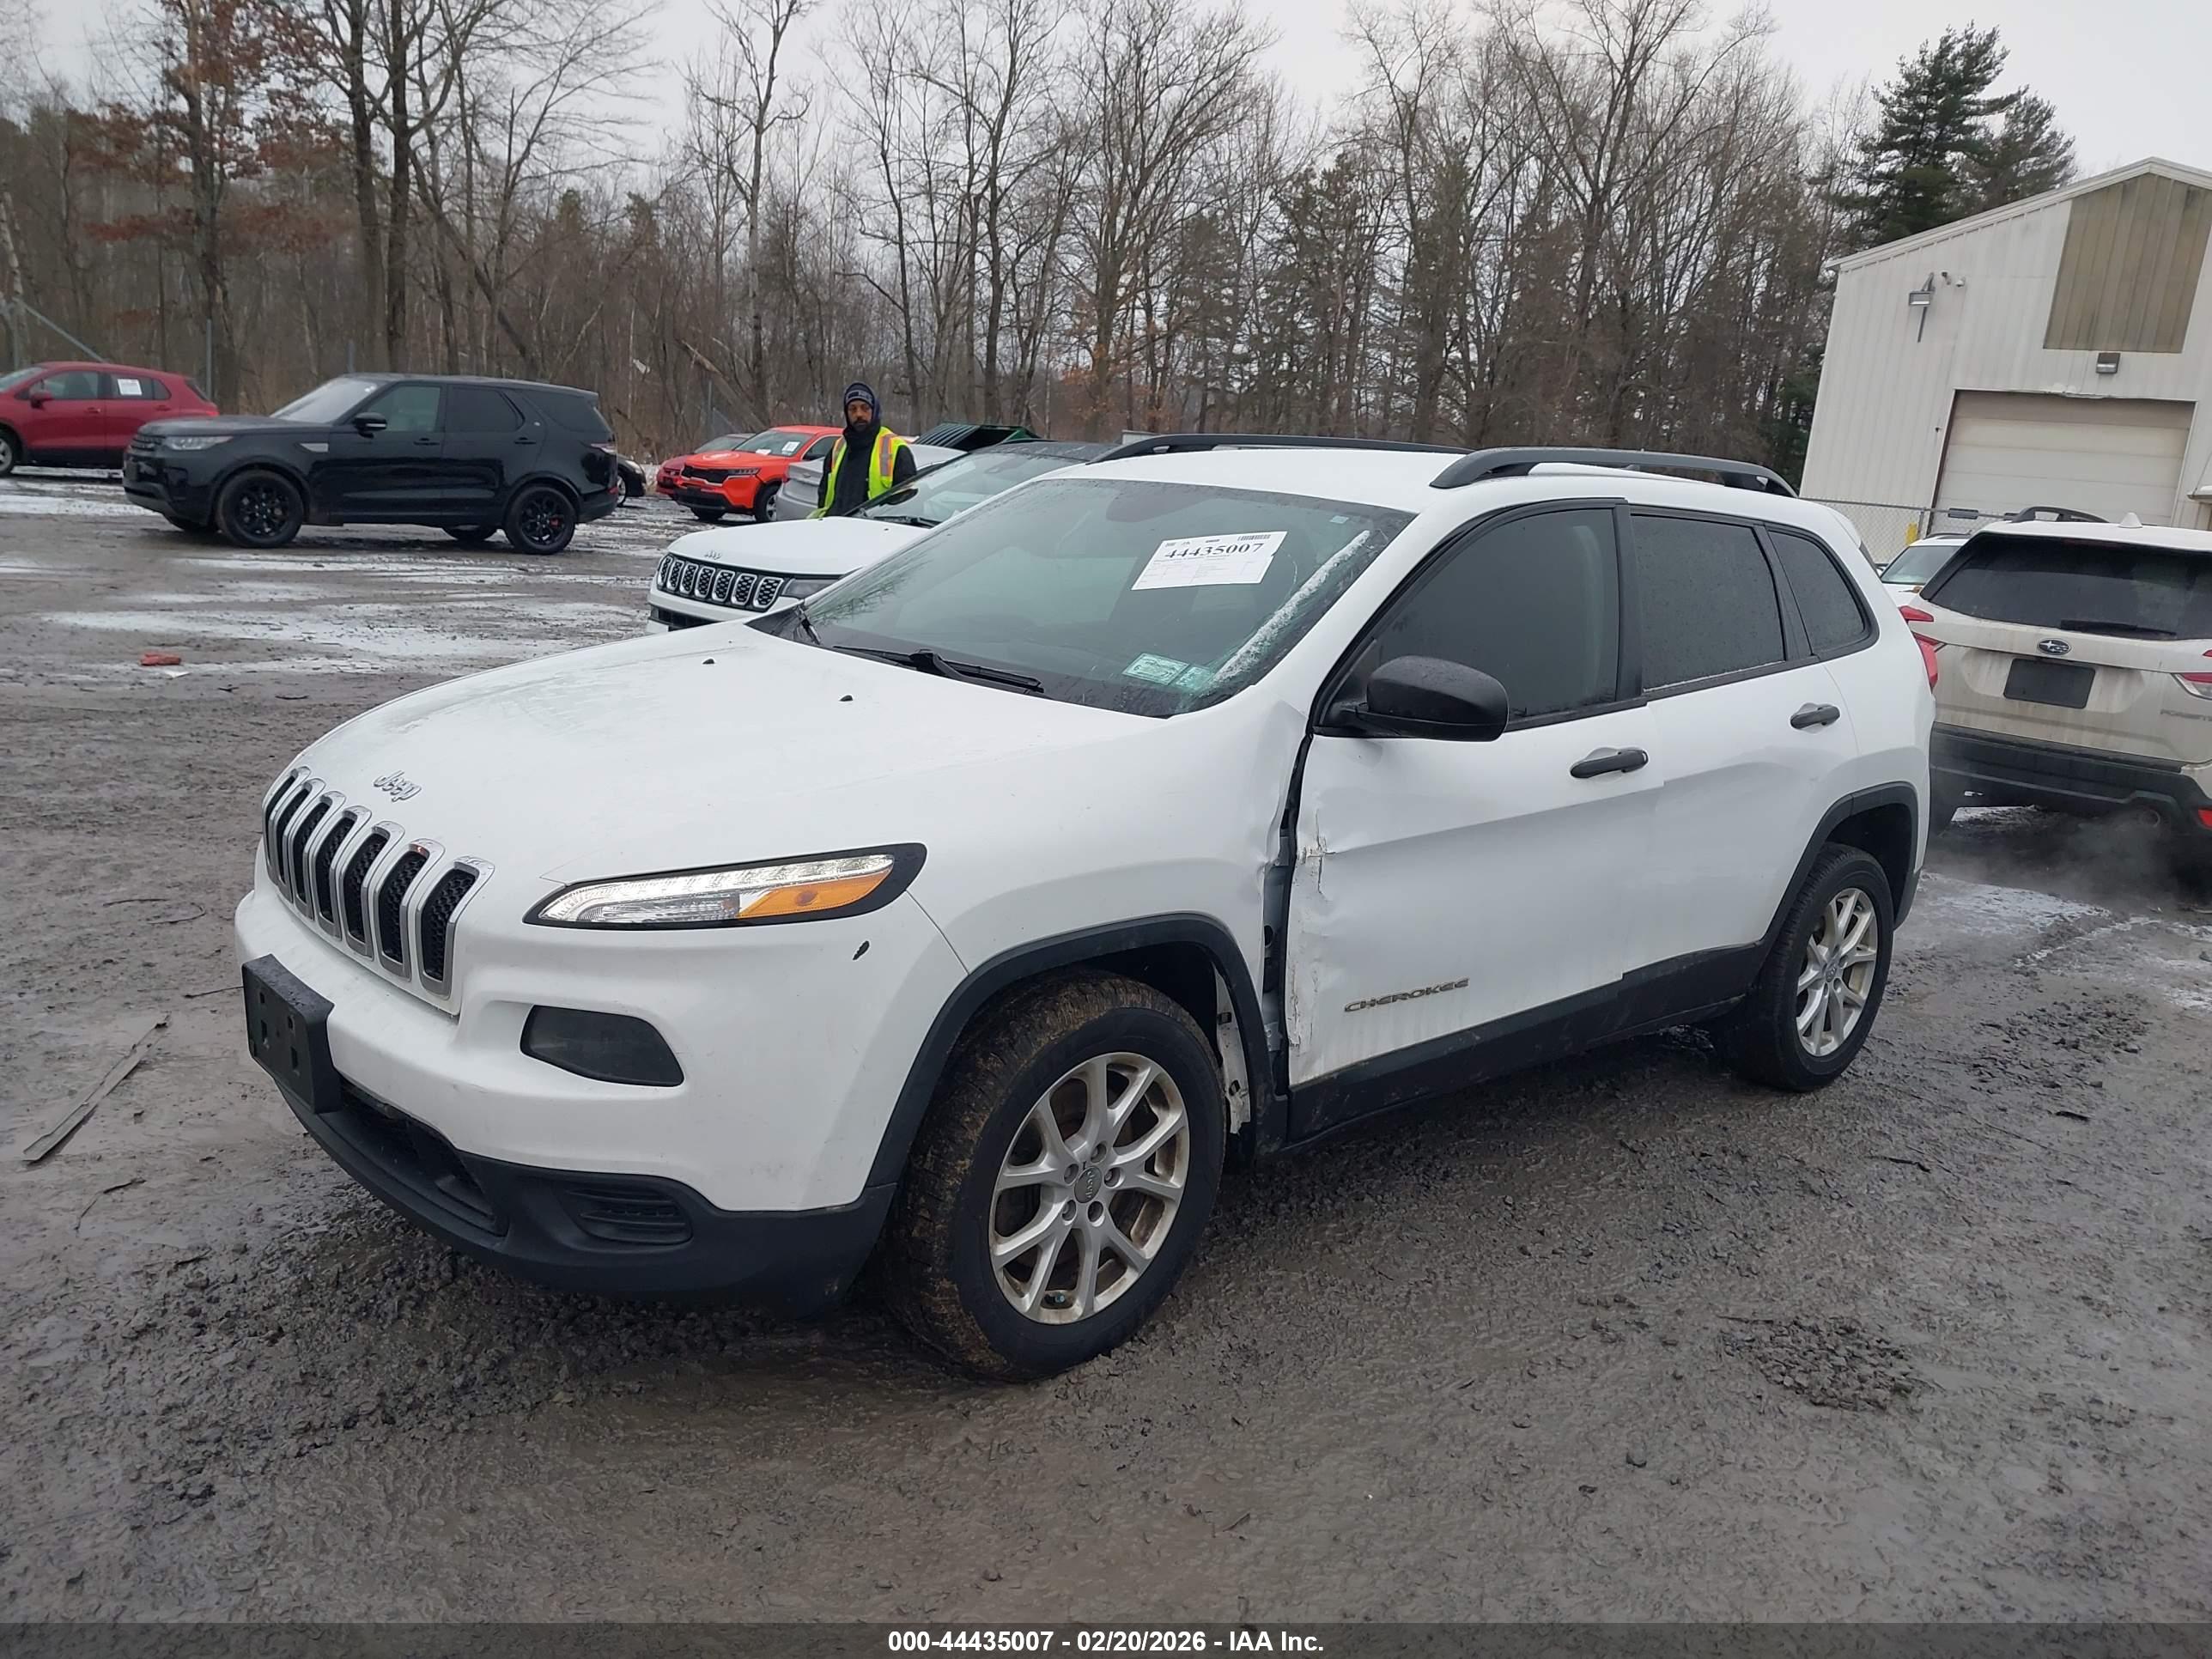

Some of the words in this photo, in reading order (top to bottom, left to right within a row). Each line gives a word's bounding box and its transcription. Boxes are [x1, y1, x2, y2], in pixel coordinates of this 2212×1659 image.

[1164, 543, 1265, 558] 44435007
[374, 770, 422, 802] Jeep
[1344, 977, 1470, 1012] CHEROKEE
